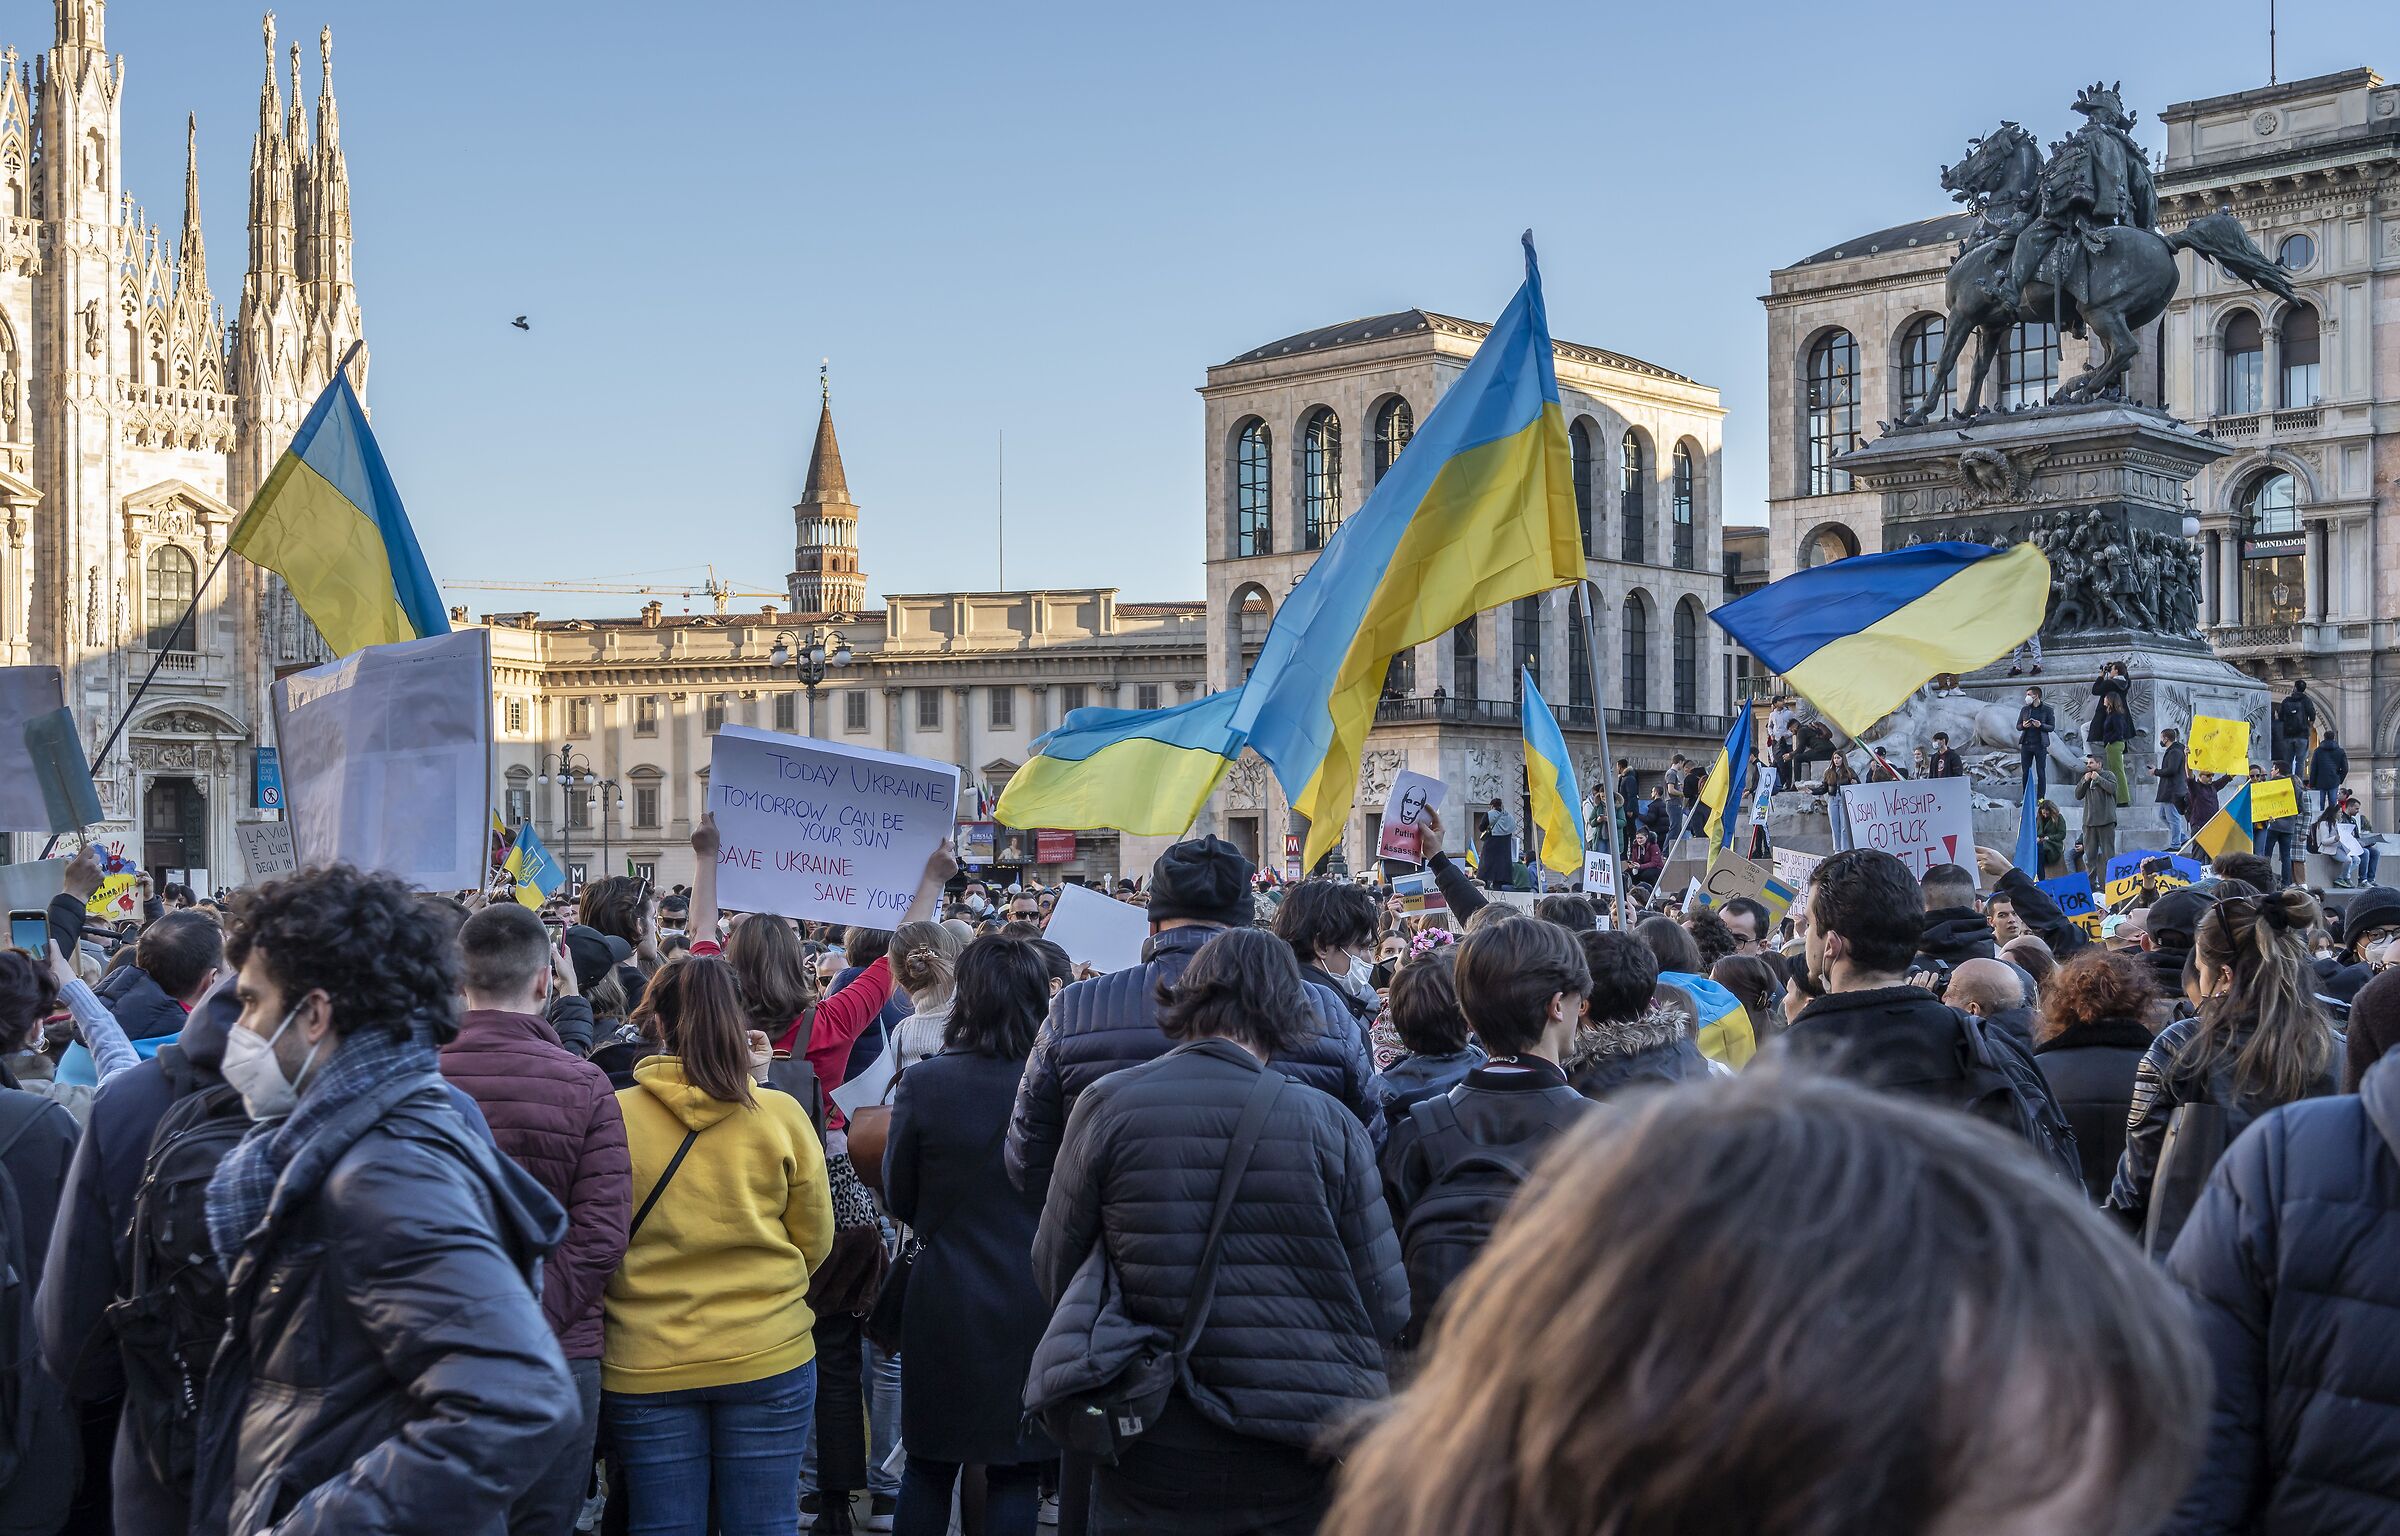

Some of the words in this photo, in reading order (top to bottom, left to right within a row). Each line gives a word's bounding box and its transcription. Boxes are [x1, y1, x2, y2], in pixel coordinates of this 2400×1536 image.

[766, 753, 839, 787] TODAY
[850, 765, 949, 811] UKRAINE,
[718, 784, 828, 822] TOMORROW
[840, 806, 875, 829] CAN
[883, 812, 904, 831] BE
[246, 830, 266, 843] LA
[799, 821, 842, 847] YOUR
[852, 828, 889, 850] SUN
[1395, 827, 1415, 839] Putin
[1868, 823, 1888, 849] GO
[1890, 819, 1928, 846] FUCK
[268, 842, 290, 855] L'ULT
[1287, 840, 1299, 851] M
[255, 861, 279, 874] DEGLI
[717, 845, 762, 870] SAVE
[775, 850, 853, 877] UKRAINE
[1589, 870, 1610, 885] PUTIN
[2114, 862, 2140, 880] PRA
[813, 882, 856, 905] SAVE
[866, 888, 943, 917] YOURSF
[2059, 892, 2091, 911] FOR
